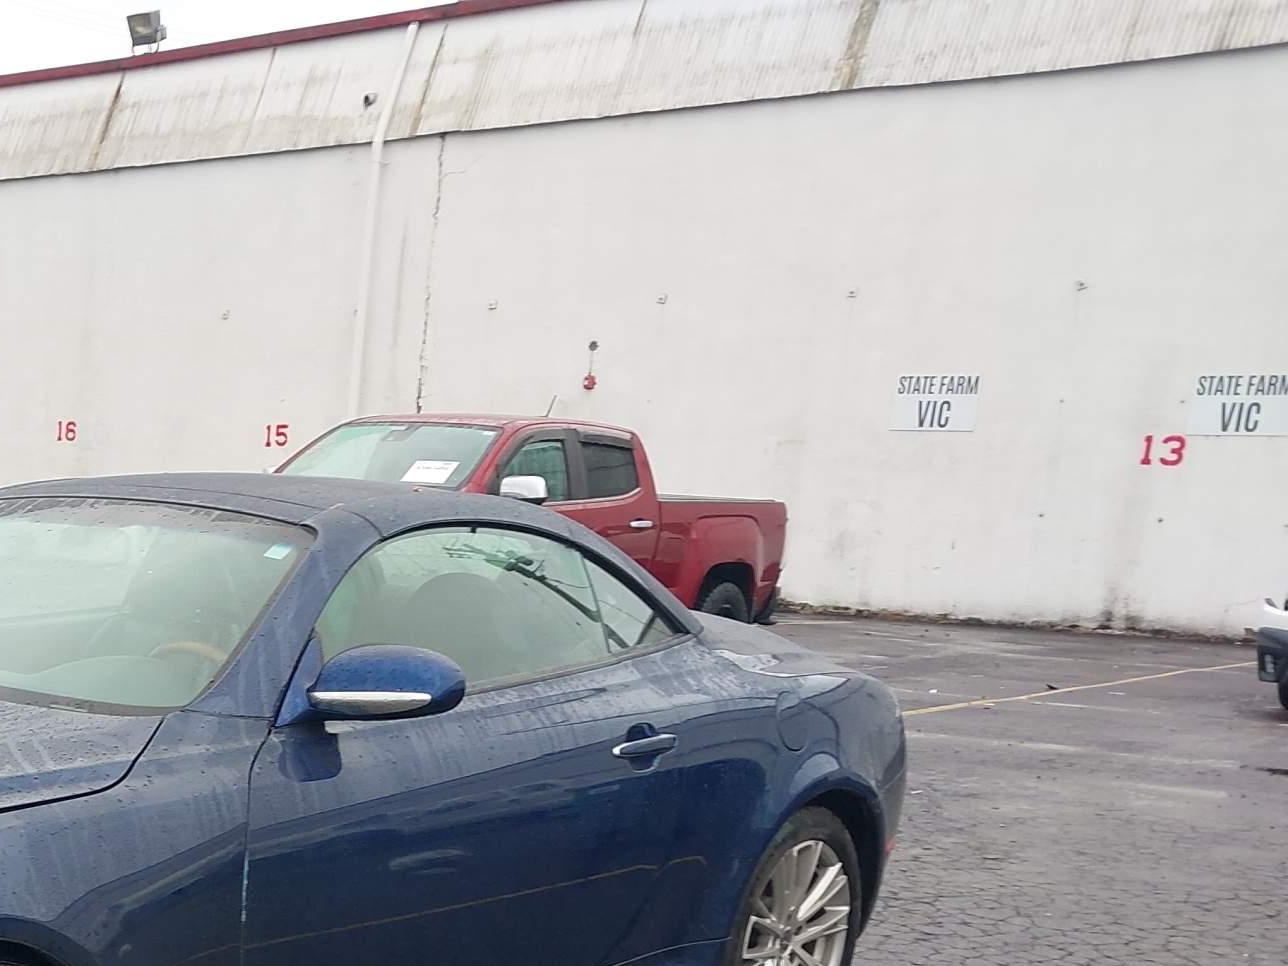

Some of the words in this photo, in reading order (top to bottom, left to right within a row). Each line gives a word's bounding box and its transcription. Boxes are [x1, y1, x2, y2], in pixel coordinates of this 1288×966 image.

[898, 376, 937, 395] STATE
[938, 376, 980, 395] FARM
[1197, 375, 1244, 396] STATE
[917, 400, 951, 428] VIC
[1220, 402, 1262, 432] VIC
[56, 421, 77, 441] 16
[264, 424, 289, 447] 15
[1140, 434, 1187, 466] 13
